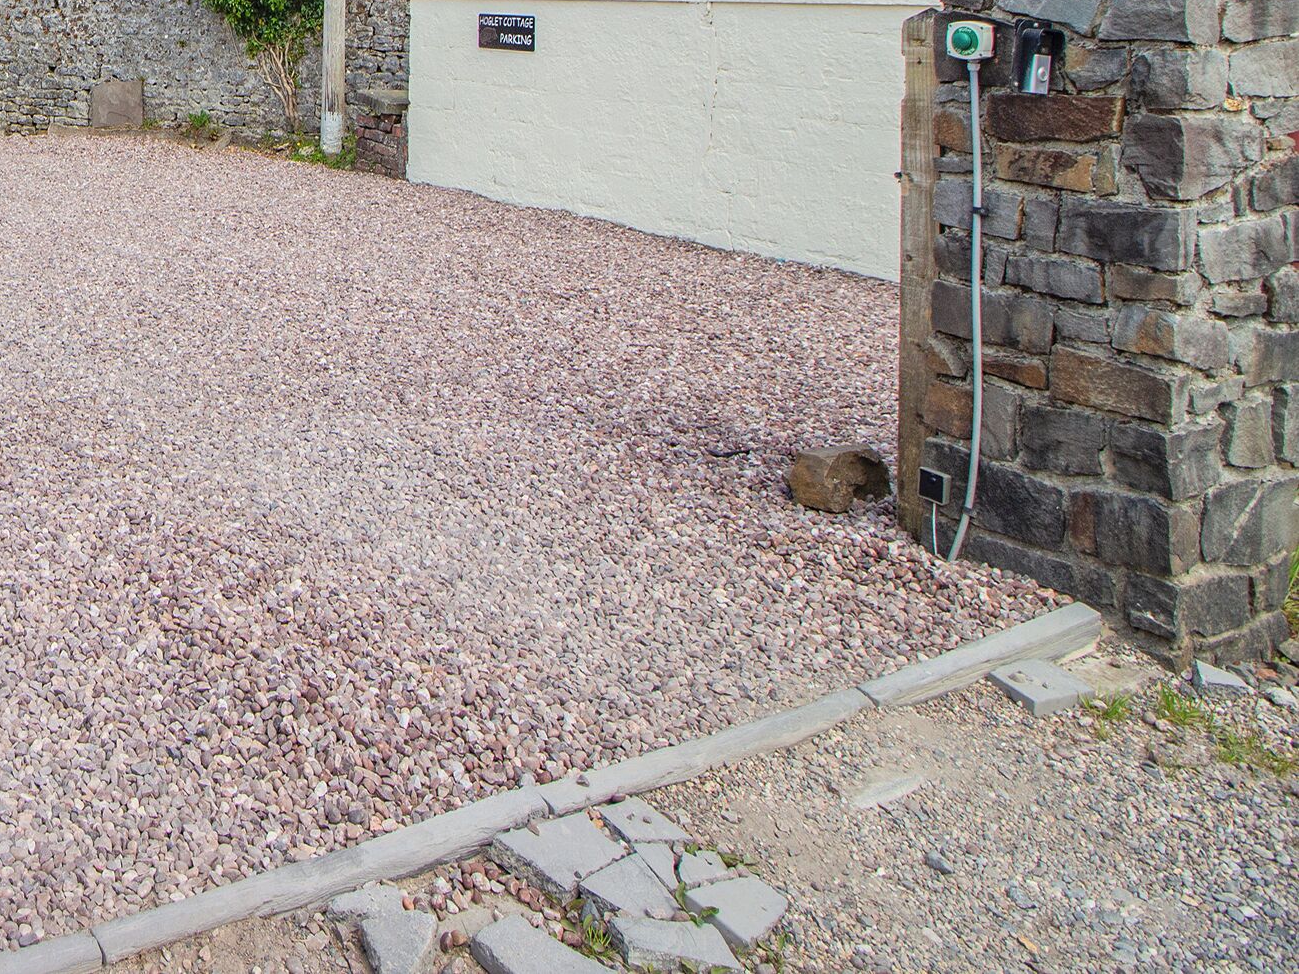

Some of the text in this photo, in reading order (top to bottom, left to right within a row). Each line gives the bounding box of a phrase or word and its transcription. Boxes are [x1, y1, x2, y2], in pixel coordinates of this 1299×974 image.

[480, 17, 533, 28] HOGLET COTTAGE
[500, 33, 532, 45] PARKING
